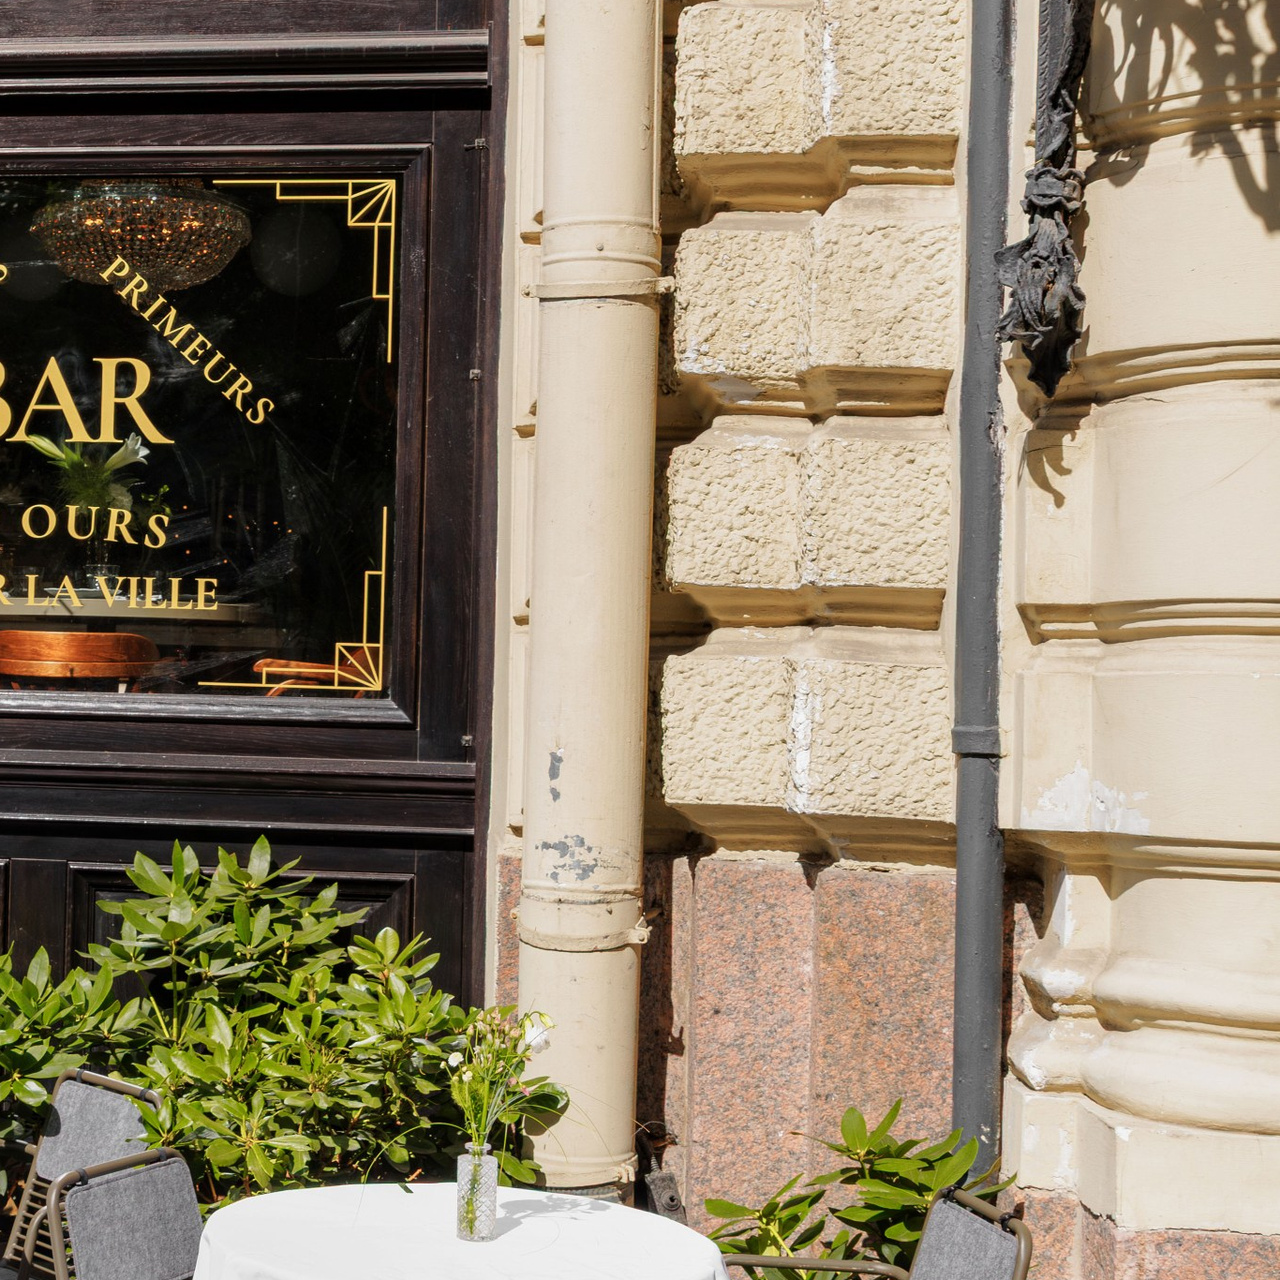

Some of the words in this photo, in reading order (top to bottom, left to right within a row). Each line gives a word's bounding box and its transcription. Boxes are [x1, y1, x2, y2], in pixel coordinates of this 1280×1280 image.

[99, 253, 276, 425] PRIMEURS
[26, 572, 84, 609] LA
[97, 575, 220, 612] VILLE
